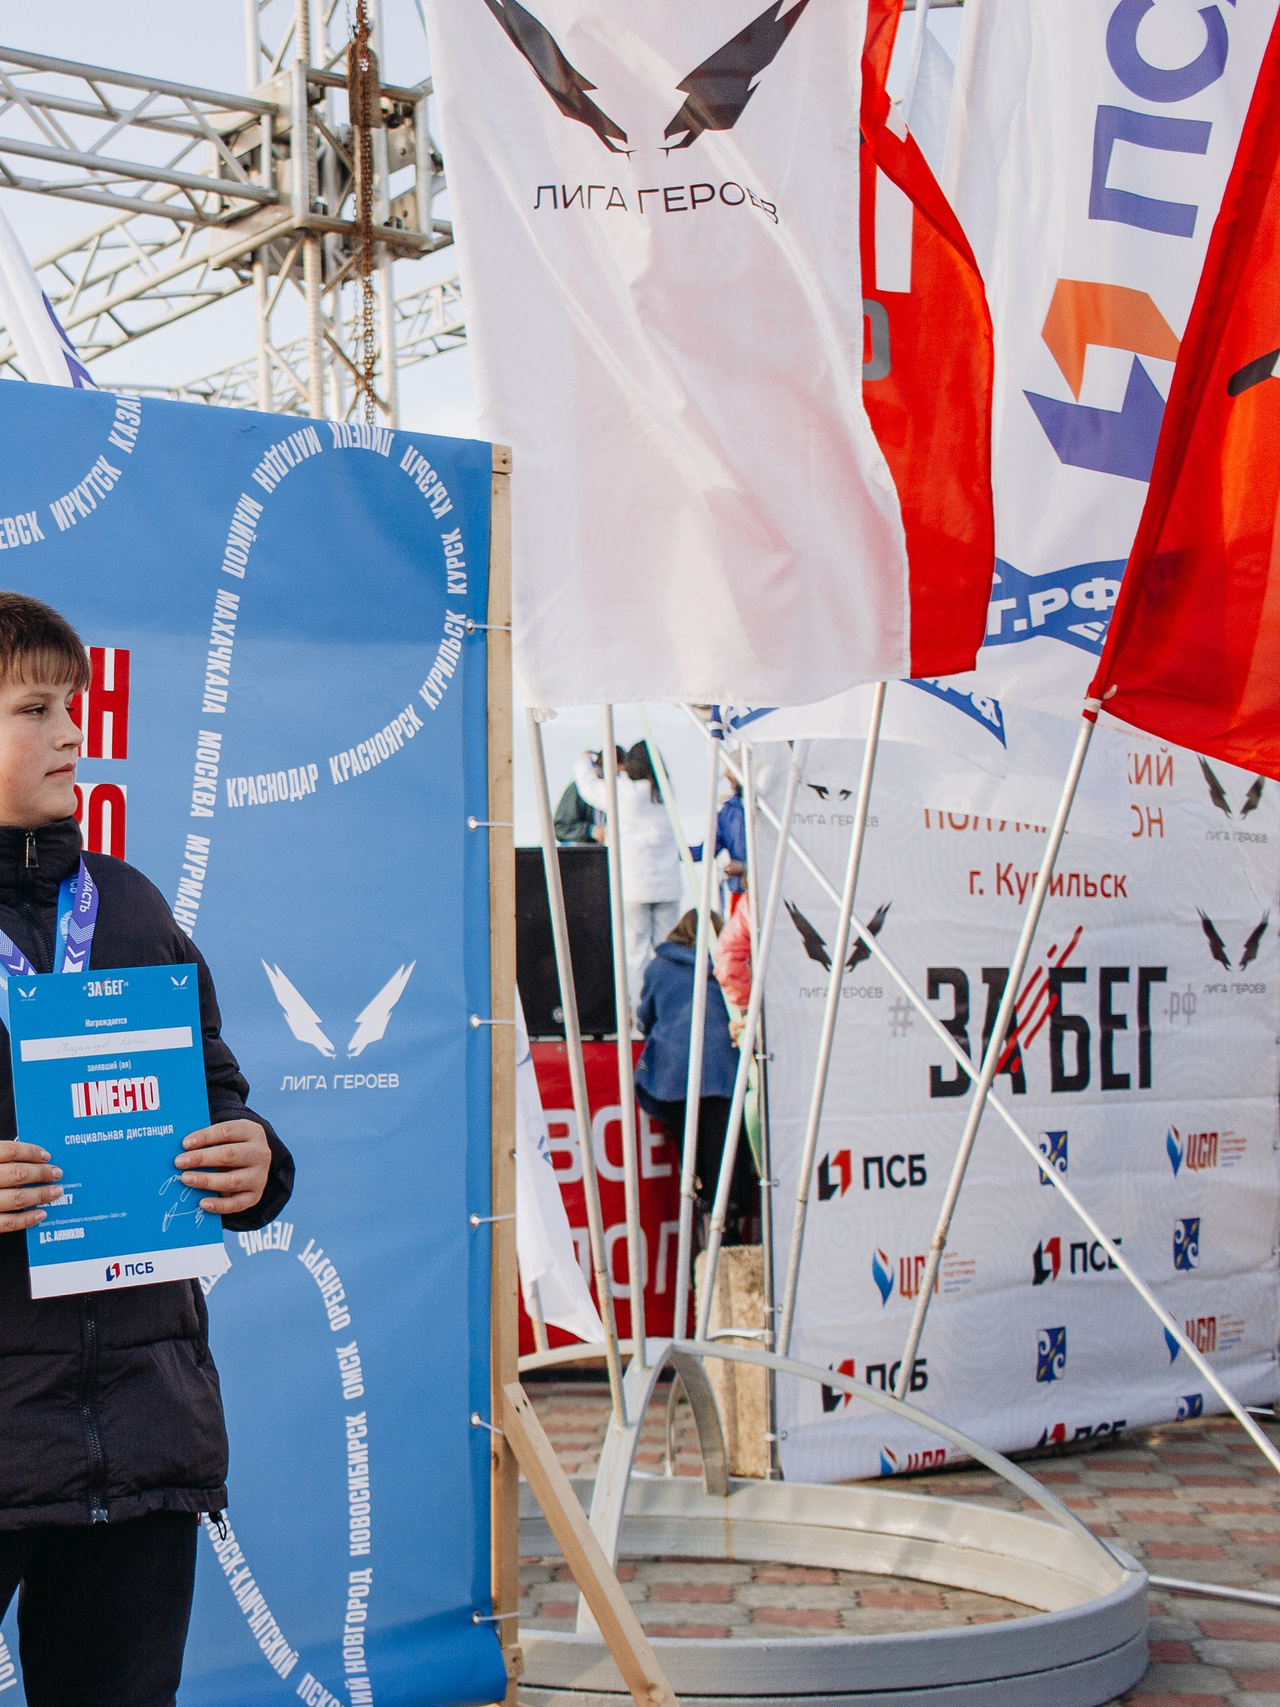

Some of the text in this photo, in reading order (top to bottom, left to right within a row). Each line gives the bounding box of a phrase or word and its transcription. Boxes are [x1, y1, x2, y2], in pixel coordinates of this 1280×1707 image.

[1088, 0, 1229, 238] ПС
[534, 181, 778, 225] ЛИГА ГЕРОЕВ
[49, 454, 122, 532] ИРКУТСК
[108, 393, 141, 454] КАЗА
[252, 425, 322, 494] МАГАДАН
[327, 421, 395, 458] ЛИПЕЦК
[399, 444, 453, 520] КЫЗЫЛ
[222, 492, 264, 579] МАЙКОП
[441, 528, 467, 594] КУРСК
[202, 588, 240, 714] МАХАЧКАЛА
[419, 609, 466, 710] КУРИЛЬСК
[190, 729, 222, 818] МОСКВА
[328, 703, 424, 785] КРАСНОЯРСК
[226, 763, 319, 807] КРАСНОДАР
[970, 870, 984, 895] г.
[85, 1017, 128, 1028] Награждается
[87, 1059, 132, 1072] занявший (ая)
[88, 1075, 160, 1116] МЕСТО
[280, 1073, 400, 1091] ЛИГА ГЕРОЕВ
[65, 1123, 174, 1146] специальная дистанция
[862, 1154, 927, 1191] ПСБ
[125, 1261, 155, 1277] ПСБ
[297, 1238, 351, 1332] ОРЕНБУРГ
[336, 1340, 365, 1400] ОМСК
[346, 1411, 371, 1557] НОВОСИБИРСК
[343, 1567, 373, 1673] НОВГОРОД
